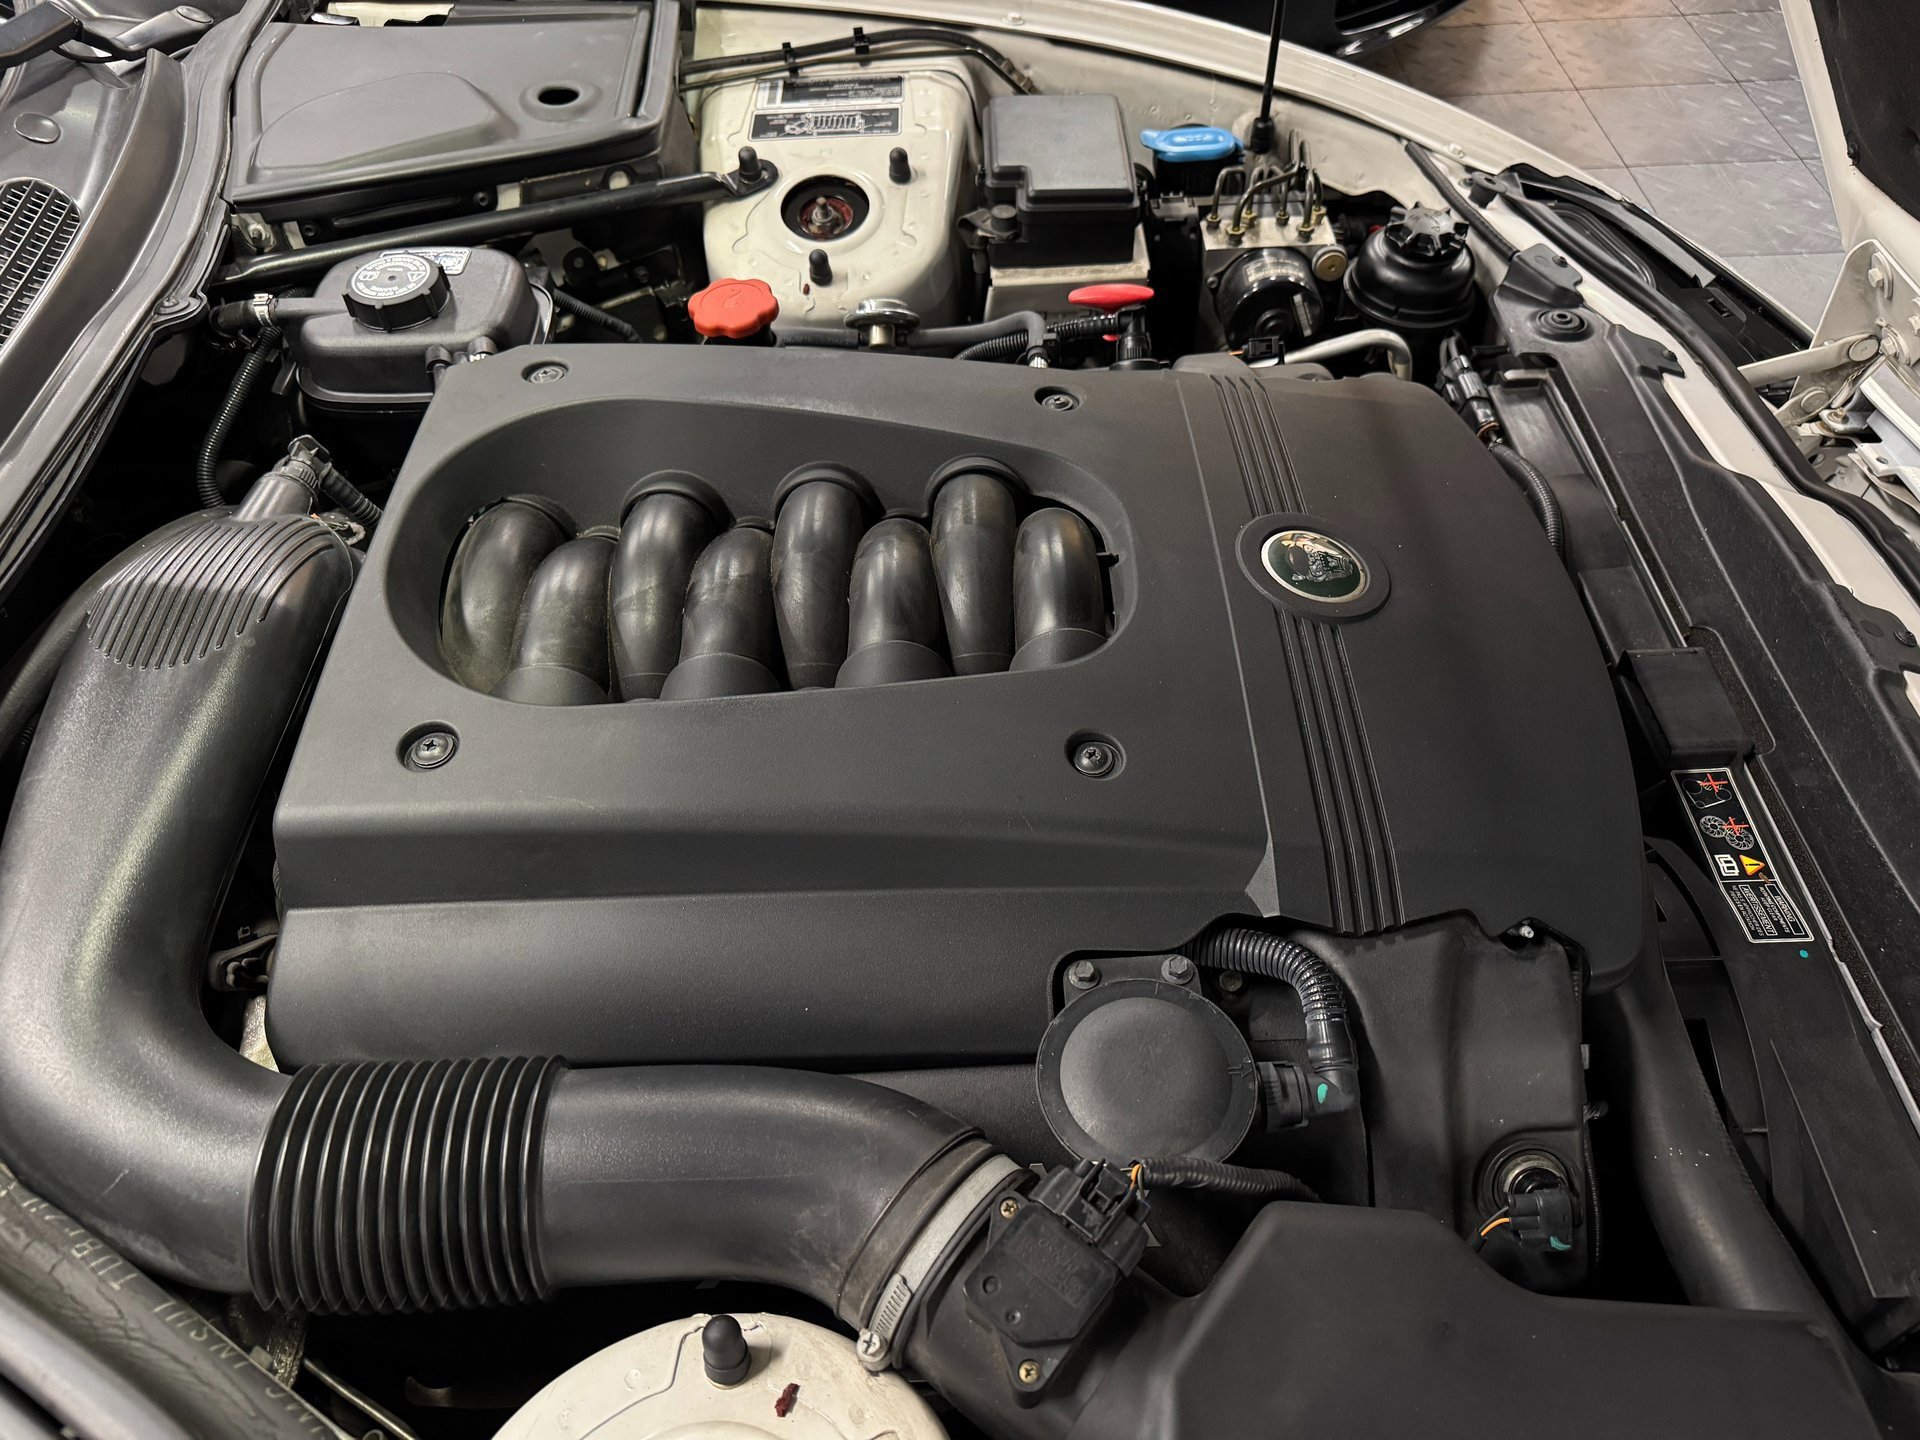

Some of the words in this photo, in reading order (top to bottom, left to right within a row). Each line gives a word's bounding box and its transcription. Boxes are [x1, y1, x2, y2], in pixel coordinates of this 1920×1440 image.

[1742, 887, 1775, 934] AVERTISSEMENT
[1767, 908, 1778, 921] CLEAR
[1775, 896, 1795, 922] WARNING
